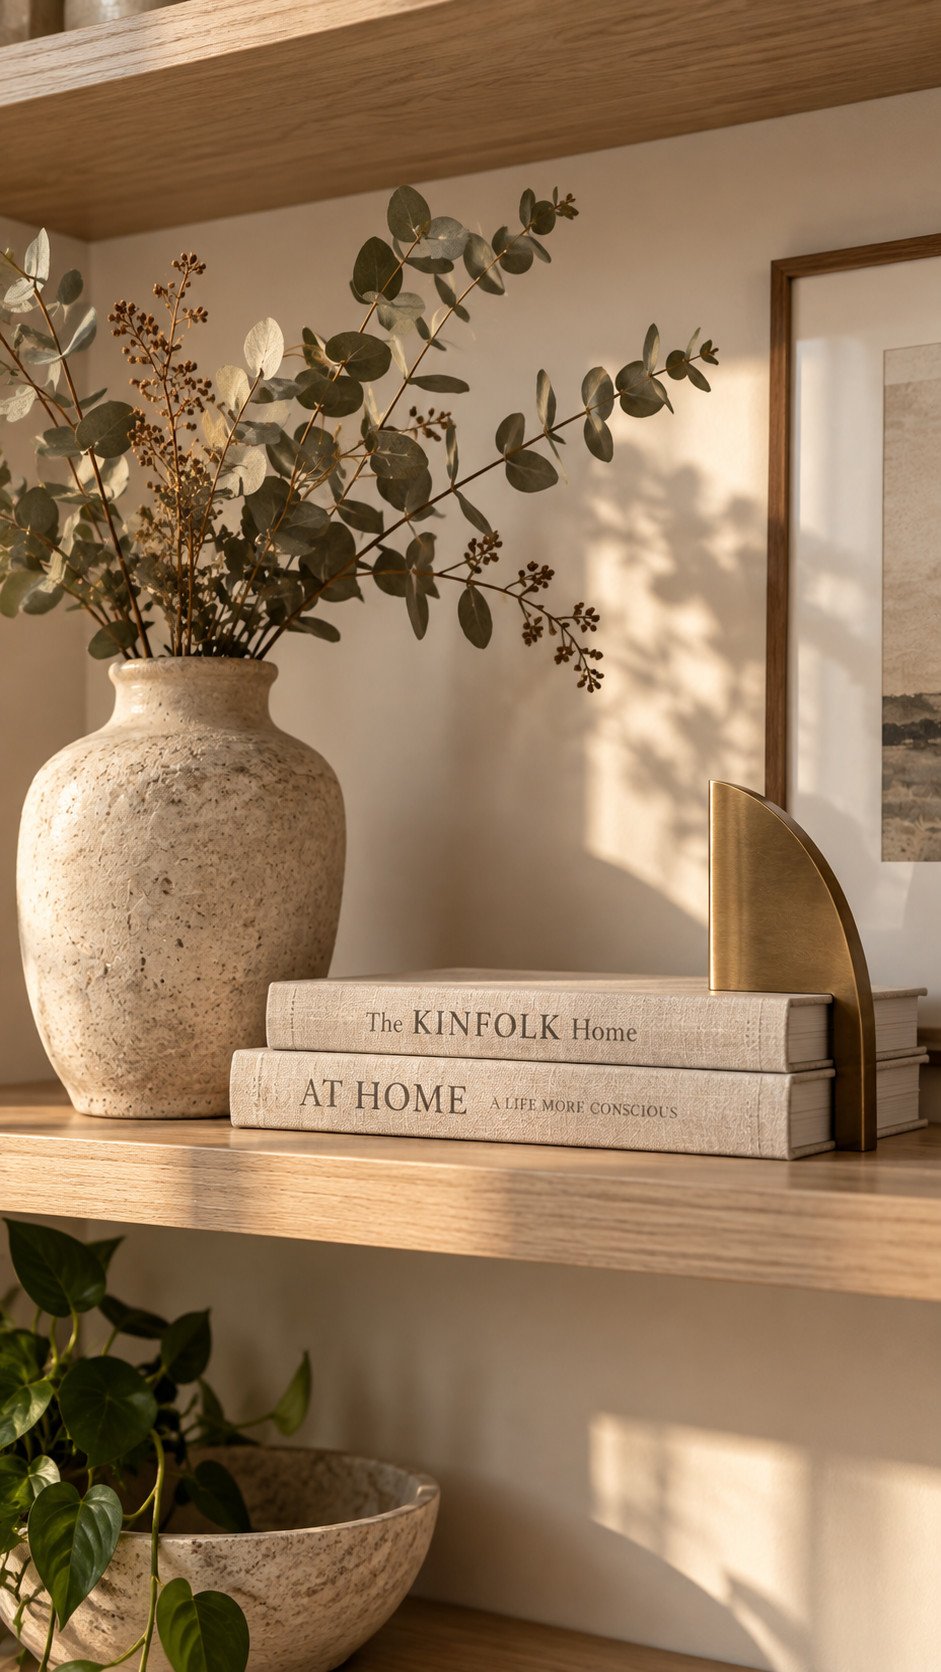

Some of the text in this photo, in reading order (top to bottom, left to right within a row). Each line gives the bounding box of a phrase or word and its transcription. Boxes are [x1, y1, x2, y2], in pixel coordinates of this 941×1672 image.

[366, 1009, 638, 1042] The KINFOLK Home
[300, 1078, 678, 1118] AT HOME A LIFE MORE CONSCIOUS
